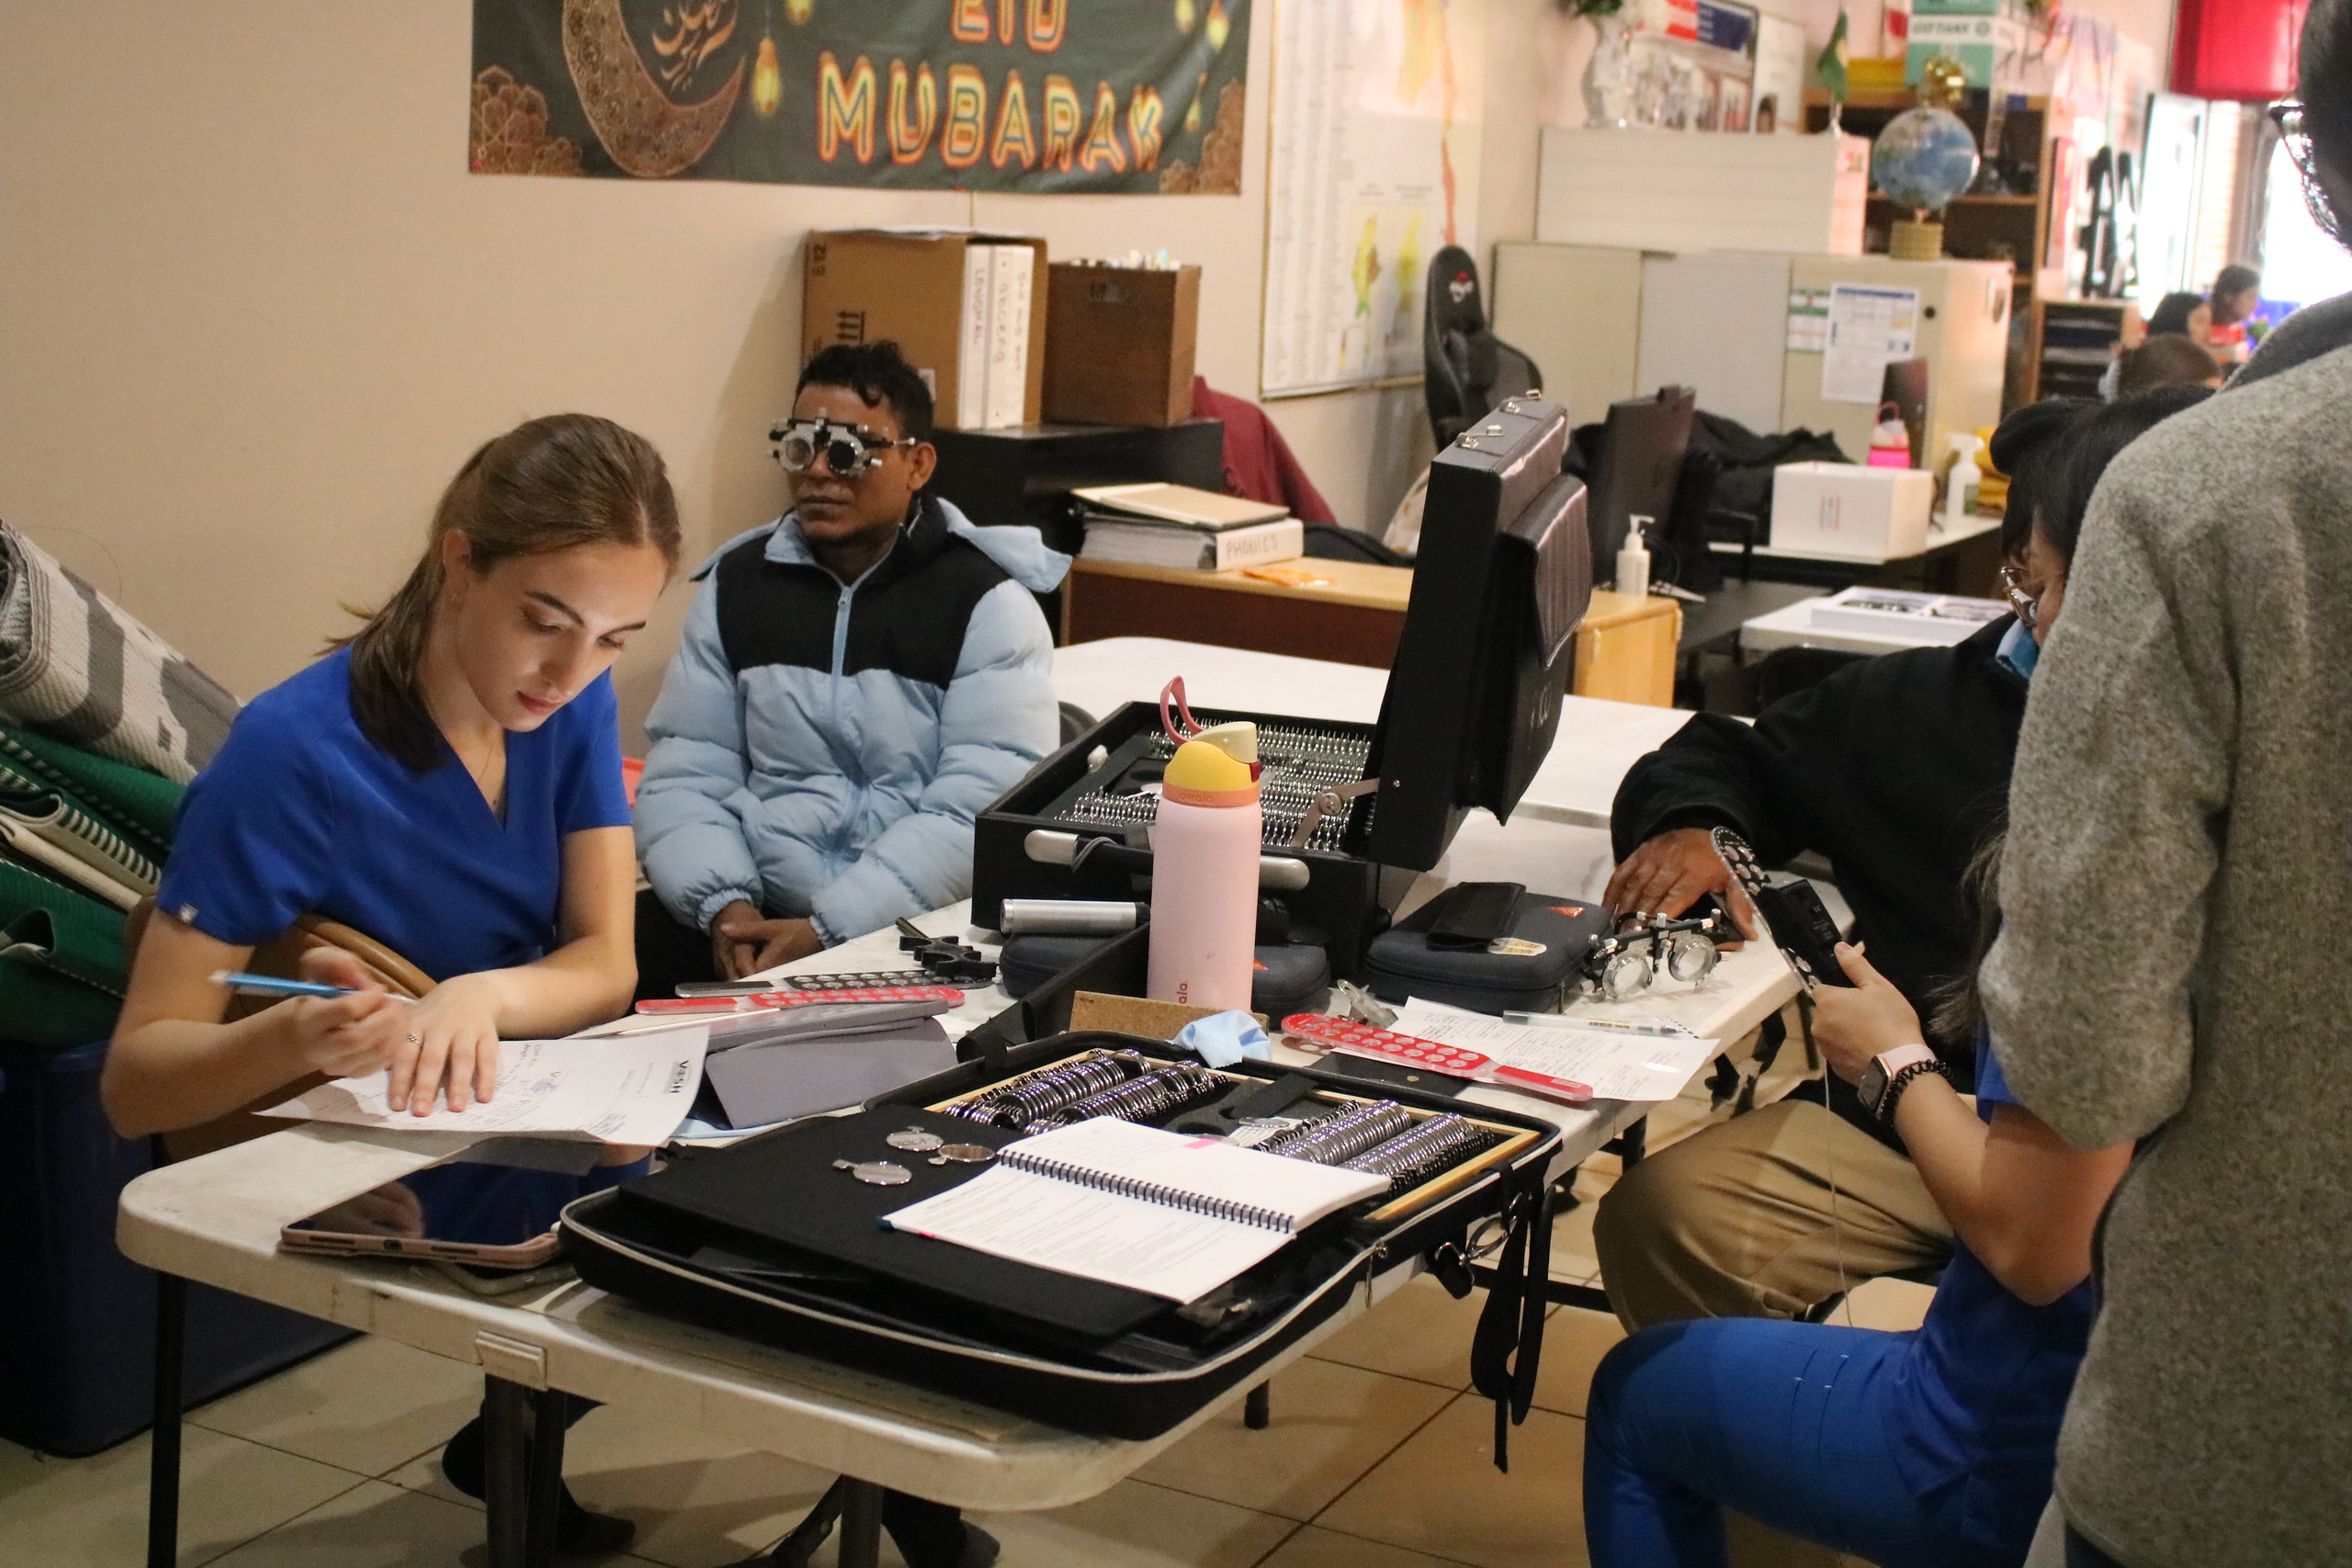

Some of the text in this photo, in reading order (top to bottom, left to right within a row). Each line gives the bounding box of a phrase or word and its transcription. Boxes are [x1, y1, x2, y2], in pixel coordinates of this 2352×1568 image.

[817, 51, 1163, 174] MUBARAK
[1226, 534, 1278, 559] PHONICS
[1177, 983, 1188, 1005] ala
